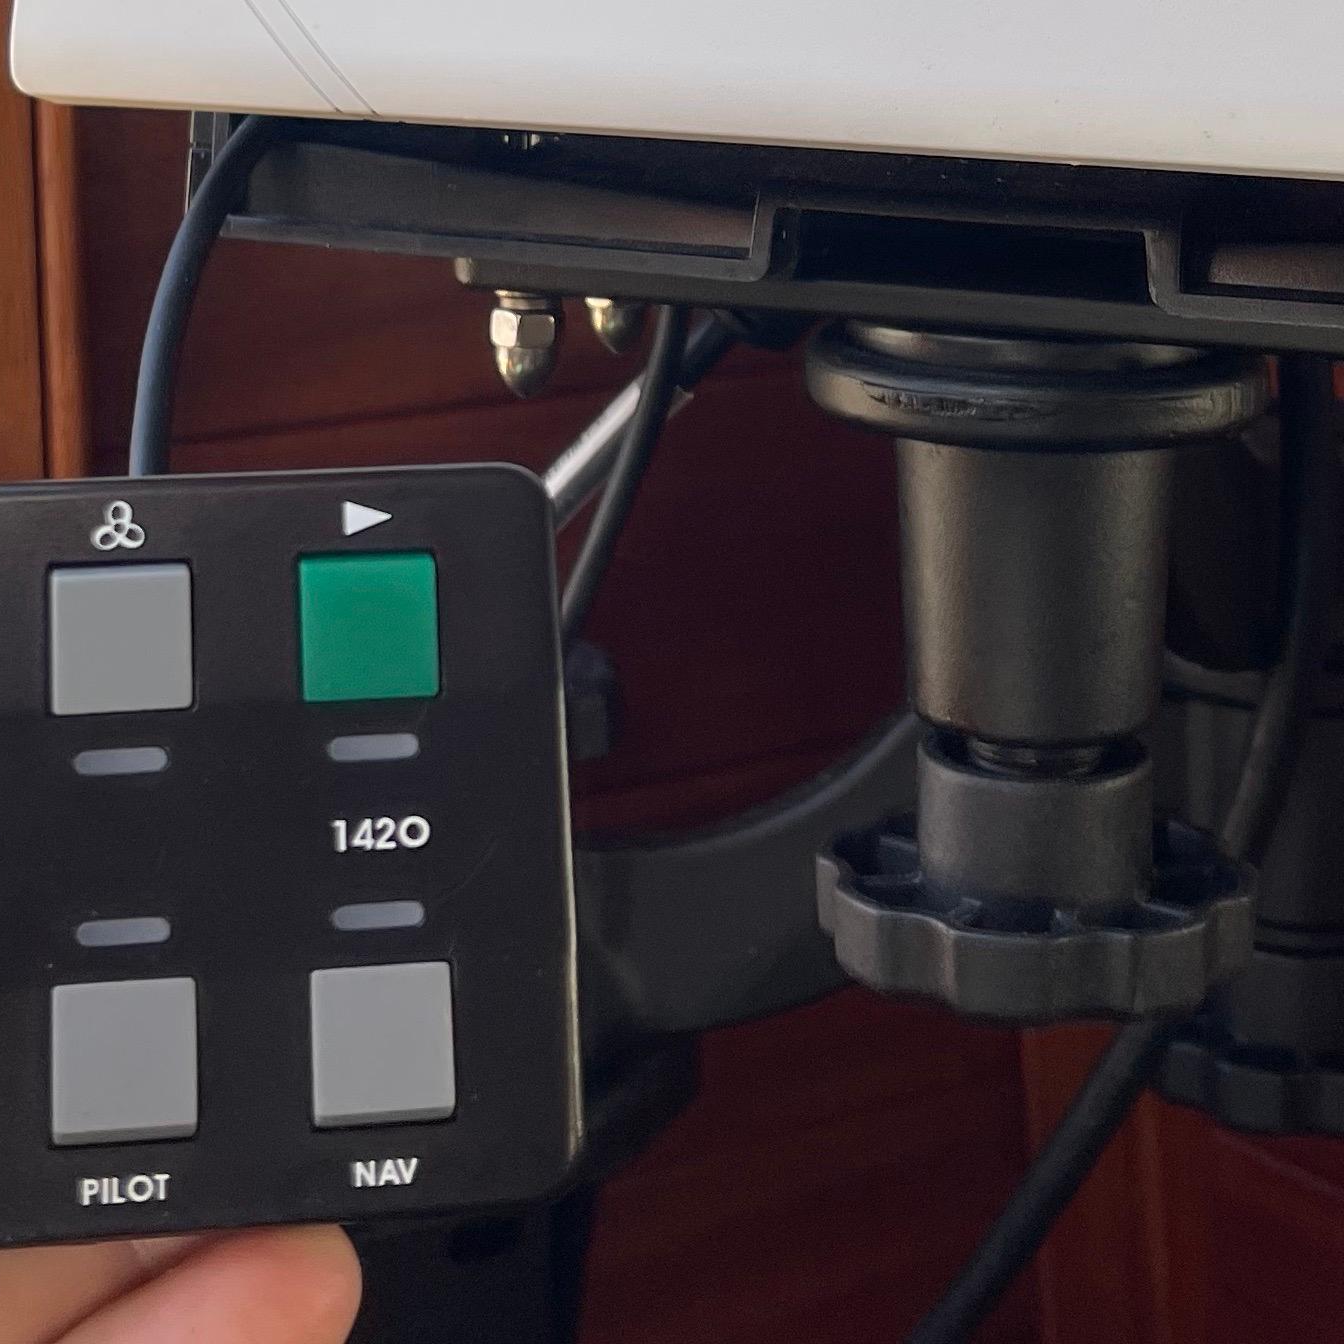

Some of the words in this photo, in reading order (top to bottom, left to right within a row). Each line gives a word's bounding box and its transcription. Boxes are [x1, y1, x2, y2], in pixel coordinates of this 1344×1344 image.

[331, 815, 431, 853] 1420
[352, 1157, 419, 1188] NAV
[81, 1173, 170, 1206] PILOT
